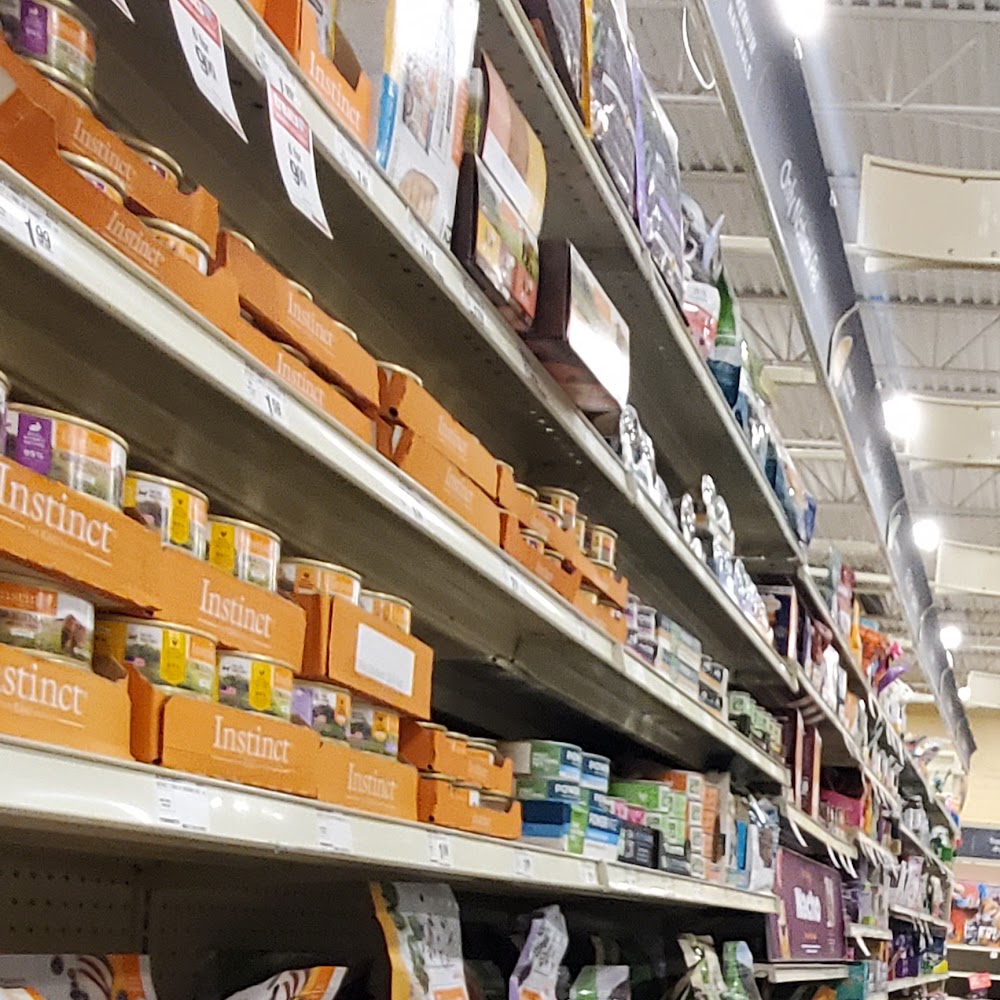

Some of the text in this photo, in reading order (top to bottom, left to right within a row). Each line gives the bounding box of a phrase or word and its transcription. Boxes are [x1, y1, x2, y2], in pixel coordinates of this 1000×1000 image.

[309, 51, 361, 130] Instinct
[73, 117, 134, 179] Instinct
[105, 210, 165, 268] Instinct
[287, 292, 333, 346] Instinct
[277, 353, 325, 405] Instinct
[0, 462, 114, 553] Instinct
[200, 578, 272, 638] Instinct
[213, 715, 291, 763] Instinct
[347, 763, 396, 801] Instinct
